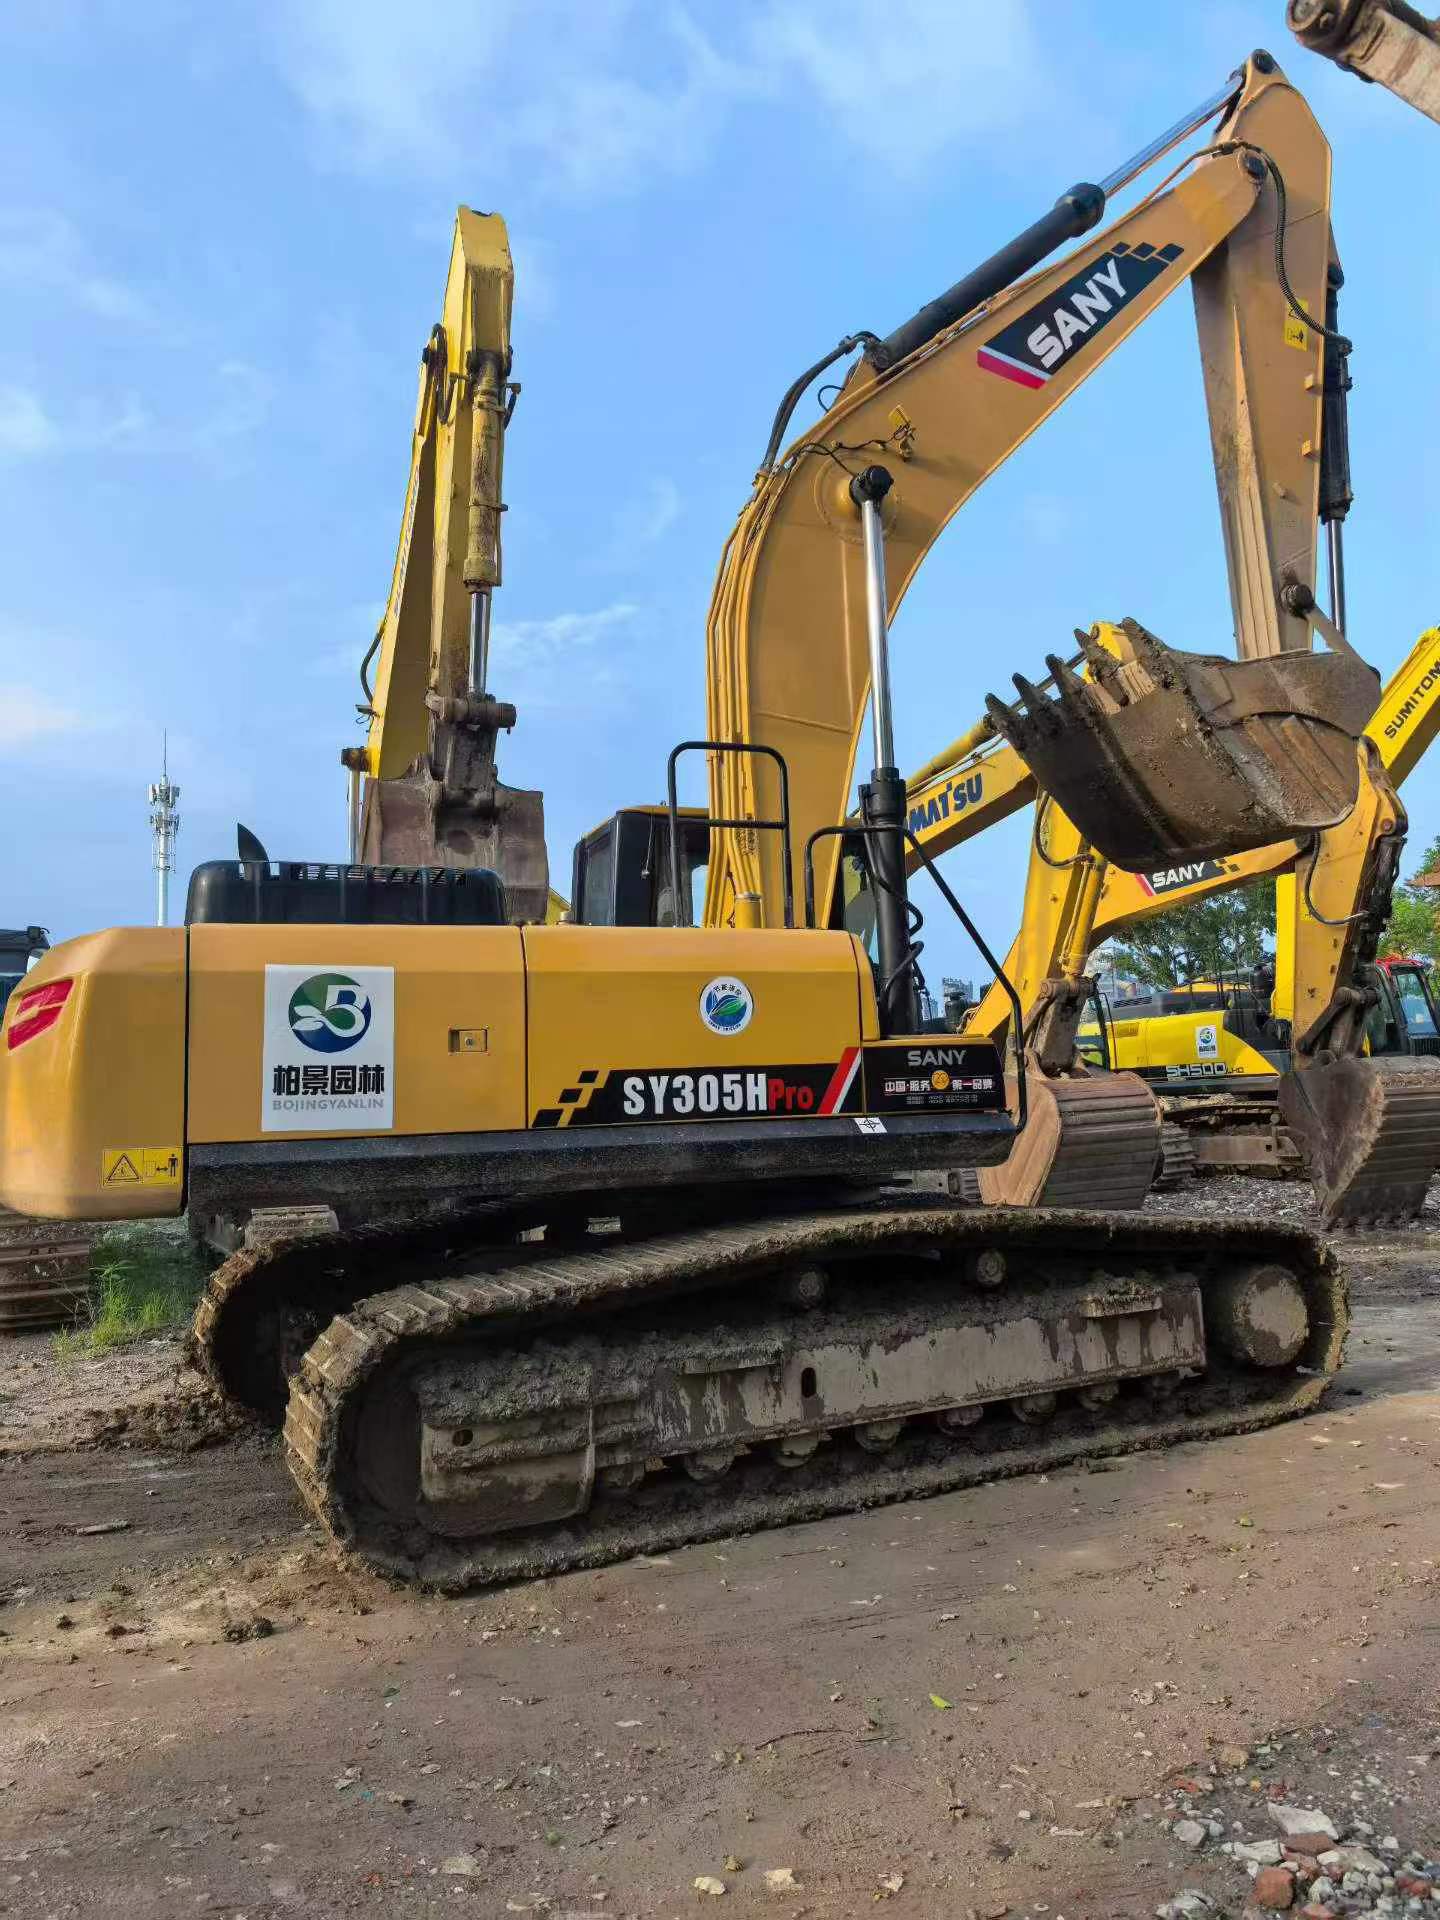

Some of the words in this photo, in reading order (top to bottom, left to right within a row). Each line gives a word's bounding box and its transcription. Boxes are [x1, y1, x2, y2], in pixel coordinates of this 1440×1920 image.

[1026, 257, 1128, 370] SANY
[908, 771, 983, 834] MATSU
[1152, 861, 1206, 888] SANY
[907, 1049, 967, 1067] SANY
[272, 1064, 385, 1096] 柏景园林
[623, 1073, 768, 1114] SY305H
[768, 1079, 814, 1112] Pro
[272, 1098, 384, 1112] BOJINGYANLIN
